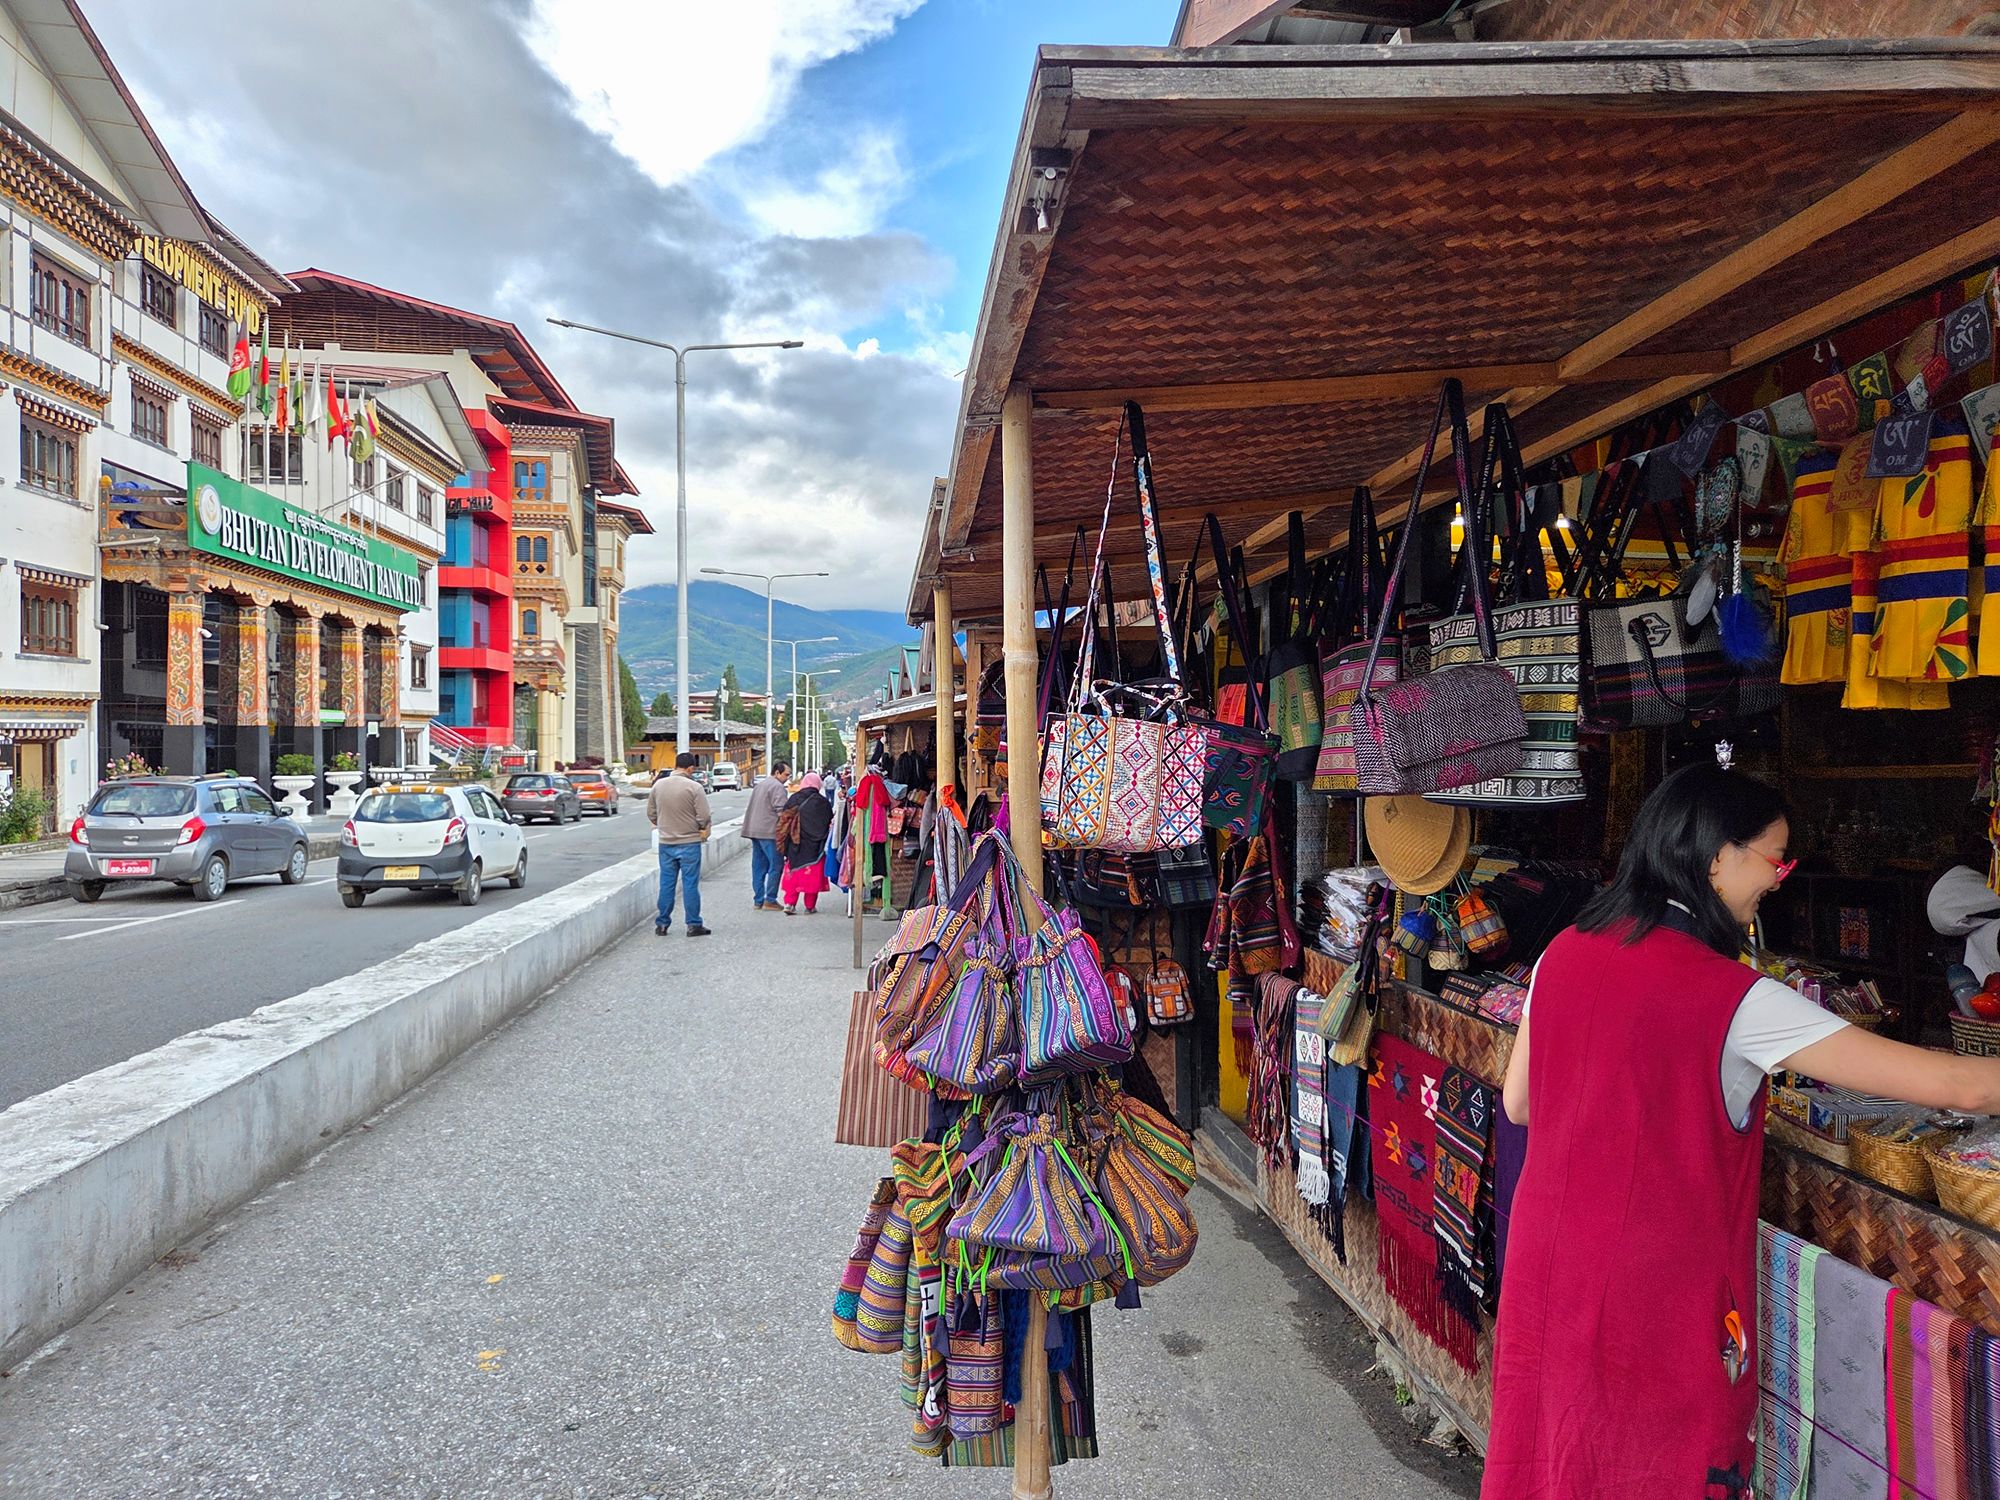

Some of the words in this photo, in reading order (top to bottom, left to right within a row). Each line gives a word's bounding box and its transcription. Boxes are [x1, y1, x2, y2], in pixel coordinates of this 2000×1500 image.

[1885, 454, 1908, 466] OM
[221, 506, 290, 567] BHUTAN
[291, 533, 374, 593] DEVELOPMENT
[376, 564, 404, 602] BANK
[404, 572, 421, 606] LTD
